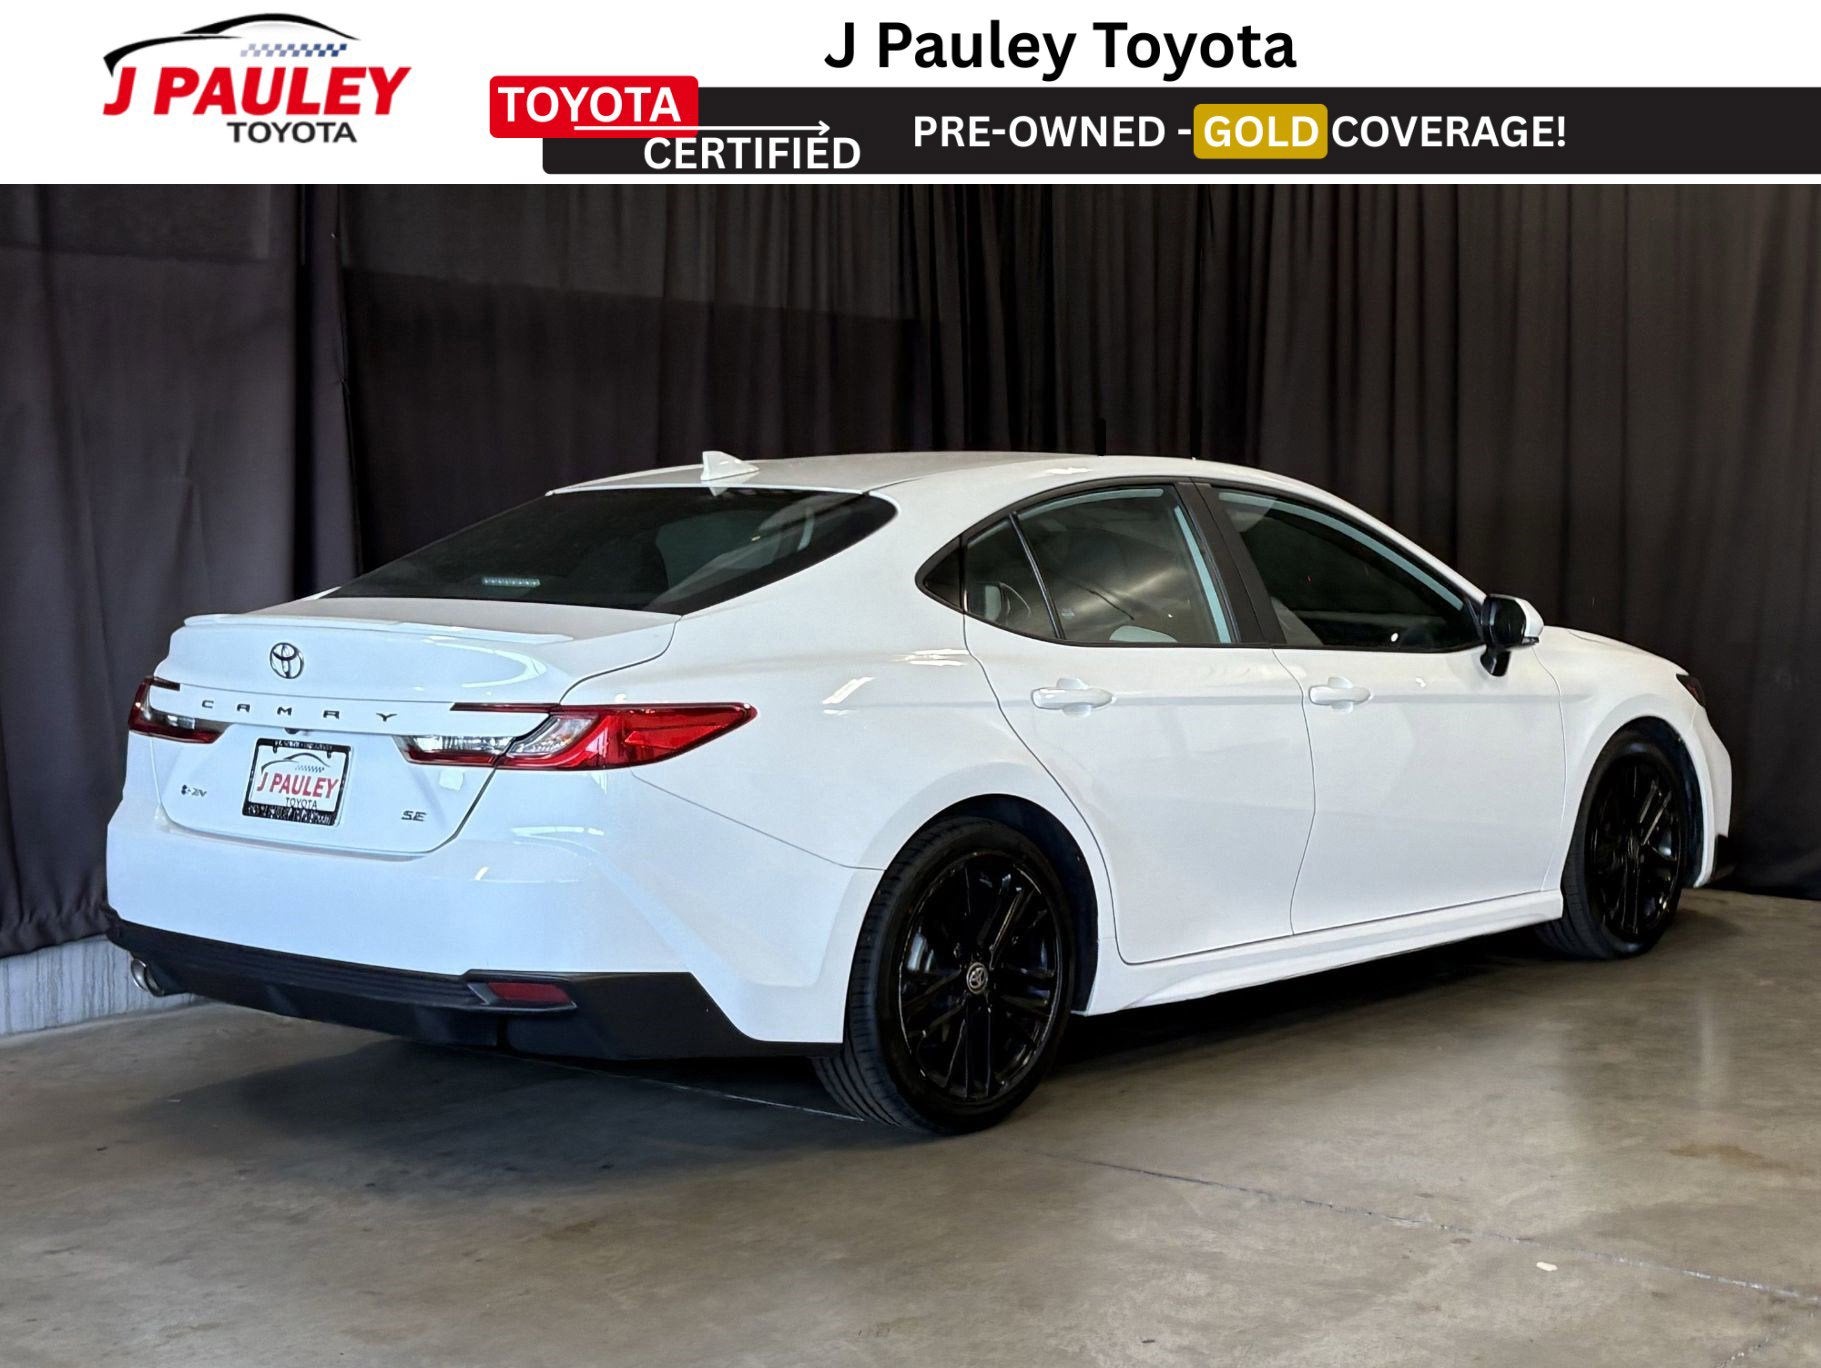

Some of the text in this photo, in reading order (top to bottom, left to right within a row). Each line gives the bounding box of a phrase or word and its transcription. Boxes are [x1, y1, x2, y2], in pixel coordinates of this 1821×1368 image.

[201, 699, 398, 722] CAMRY
[257, 771, 339, 799] J PAULEY
[285, 796, 318, 810] TOYOTA
[400, 810, 427, 822] SE
